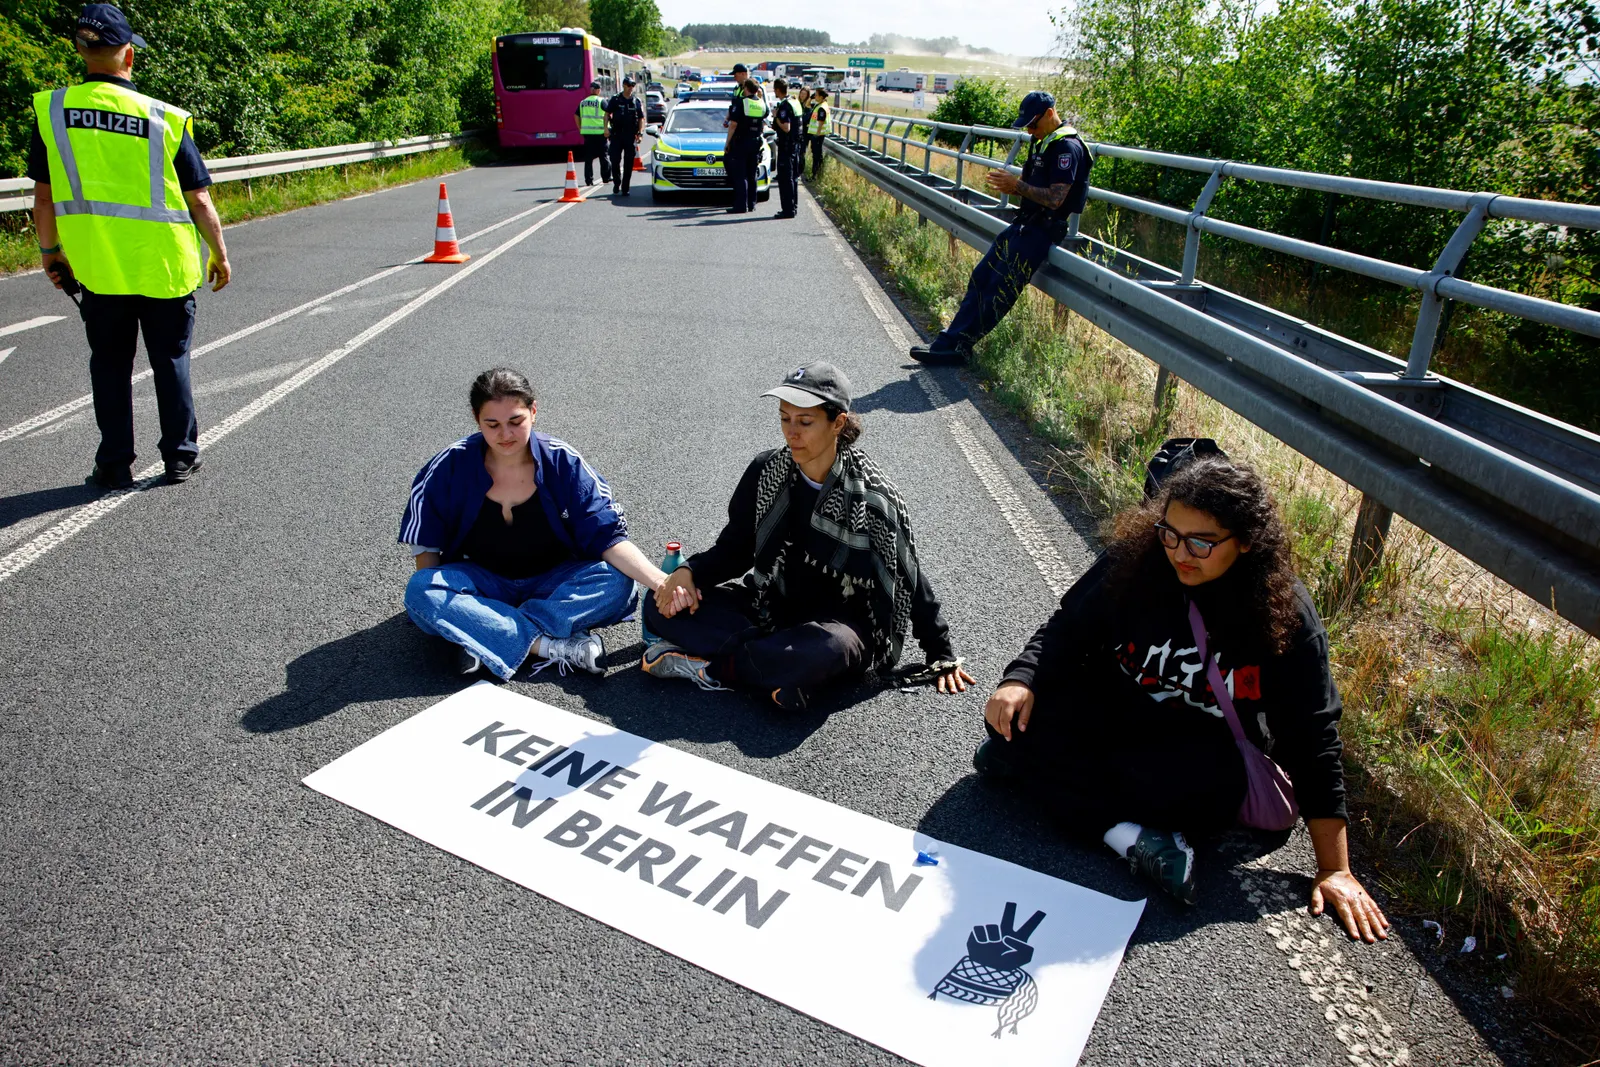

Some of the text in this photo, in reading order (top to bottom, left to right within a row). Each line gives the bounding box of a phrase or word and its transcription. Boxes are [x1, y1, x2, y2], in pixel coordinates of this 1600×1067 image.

[532, 37, 561, 45] SHUTTLEBUS
[69, 109, 144, 135] POLIZEI
[462, 720, 924, 913] KEINE WAFFEN
[470, 780, 791, 930] IN BERLIN
